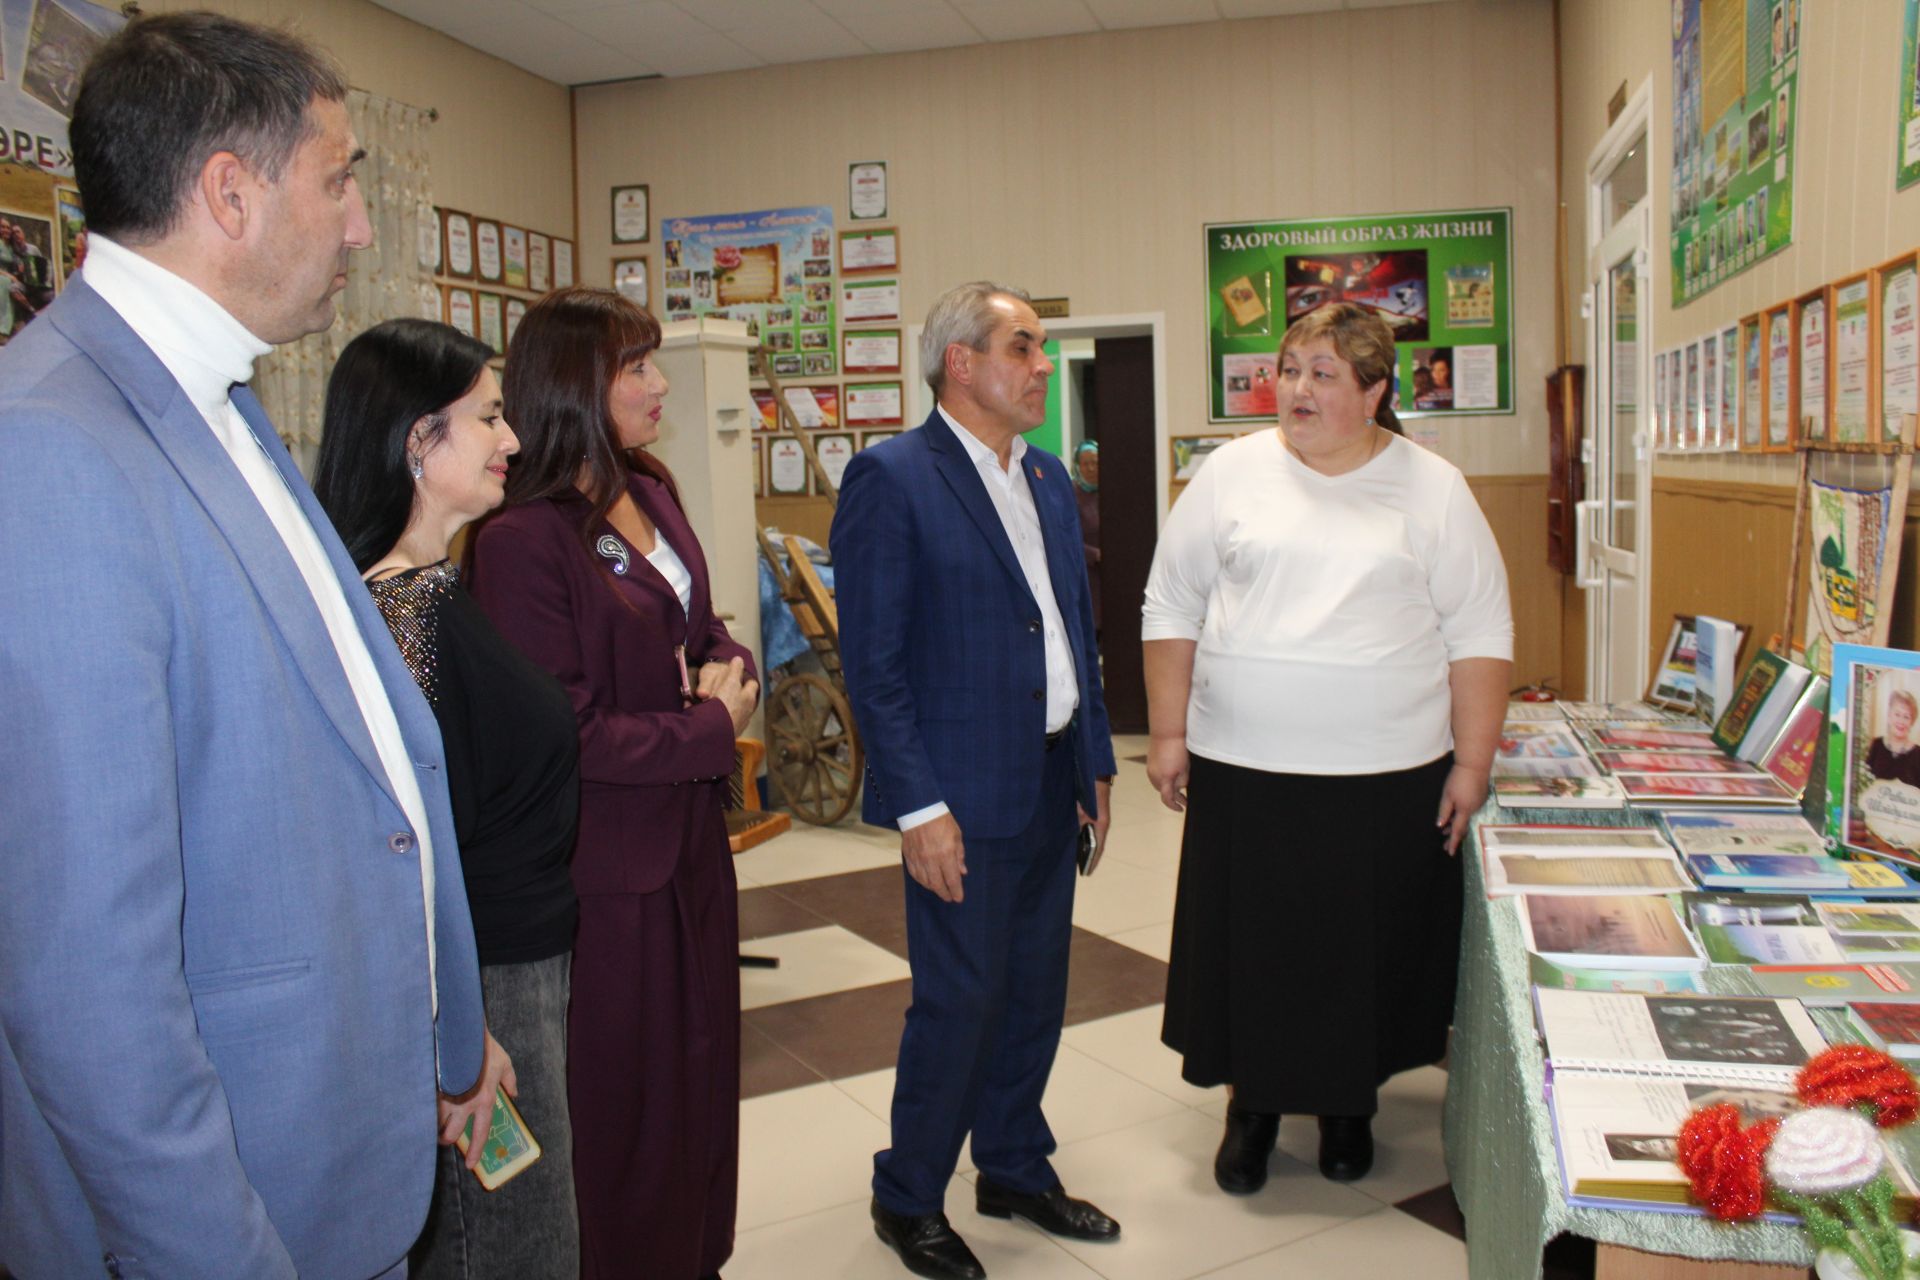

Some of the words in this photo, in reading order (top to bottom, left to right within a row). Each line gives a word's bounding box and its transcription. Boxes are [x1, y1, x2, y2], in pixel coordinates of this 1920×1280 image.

[1220, 227, 1337, 251] ЗДОРОВЫЙ
[1341, 225, 1407, 242] ОБРАЗ
[1413, 221, 1493, 238] ЖИЗНИ
